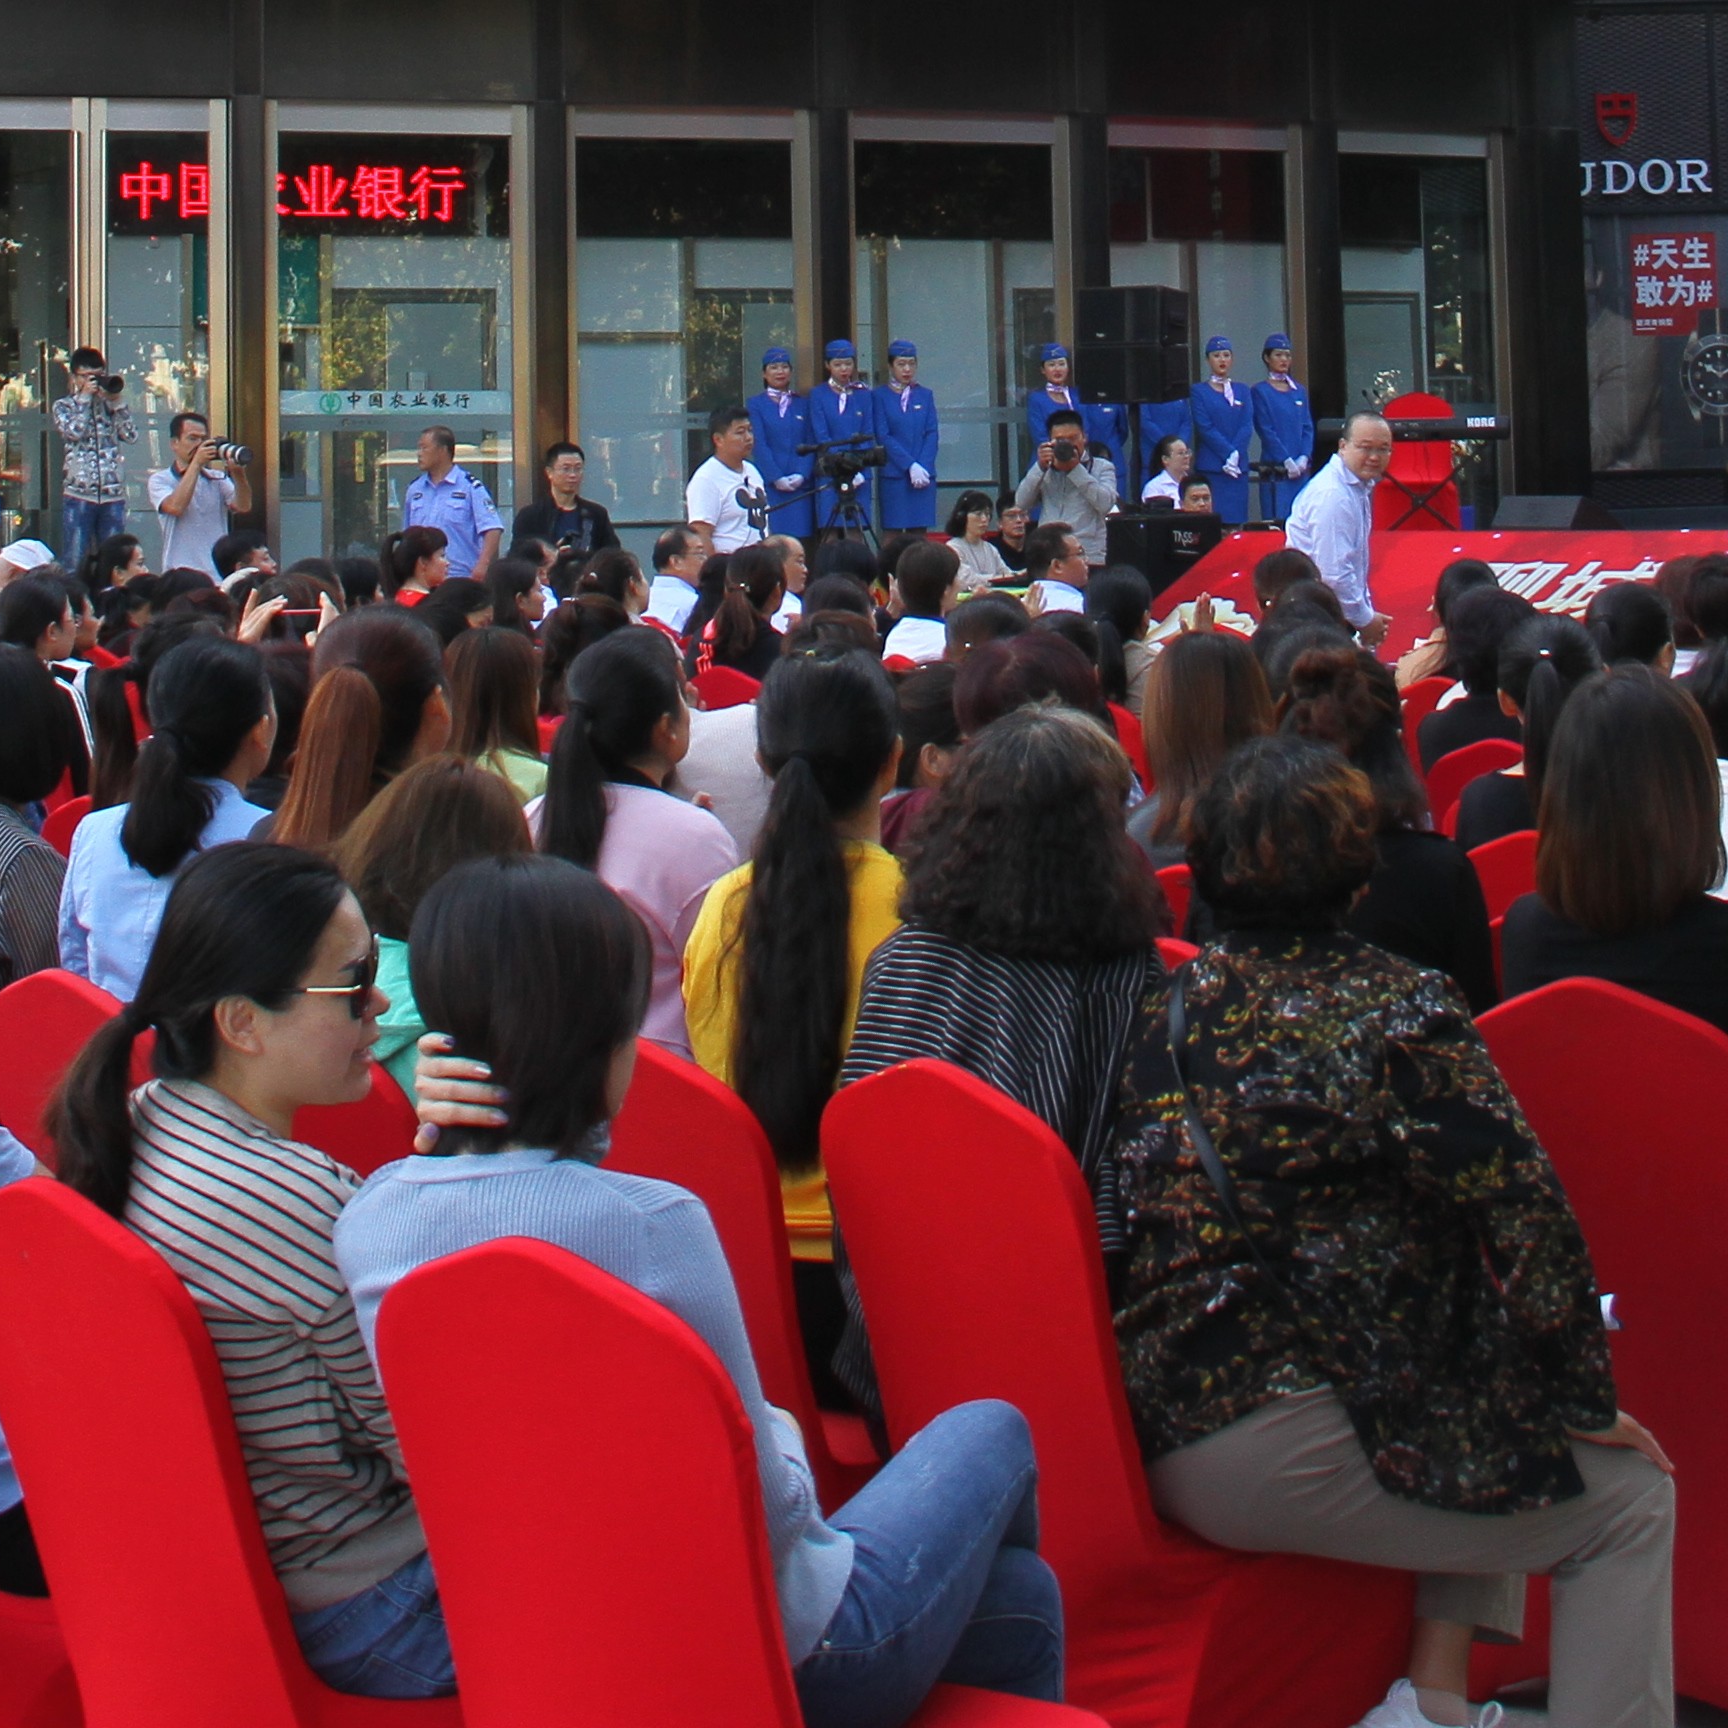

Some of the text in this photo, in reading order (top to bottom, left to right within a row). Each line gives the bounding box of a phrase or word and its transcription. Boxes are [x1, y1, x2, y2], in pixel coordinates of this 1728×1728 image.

[1633, 237, 1711, 270] #天生
[1635, 274, 1713, 308] 敢为#
[347, 391, 470, 409] 中国农业银行
[1466, 416, 1496, 428] KORG
